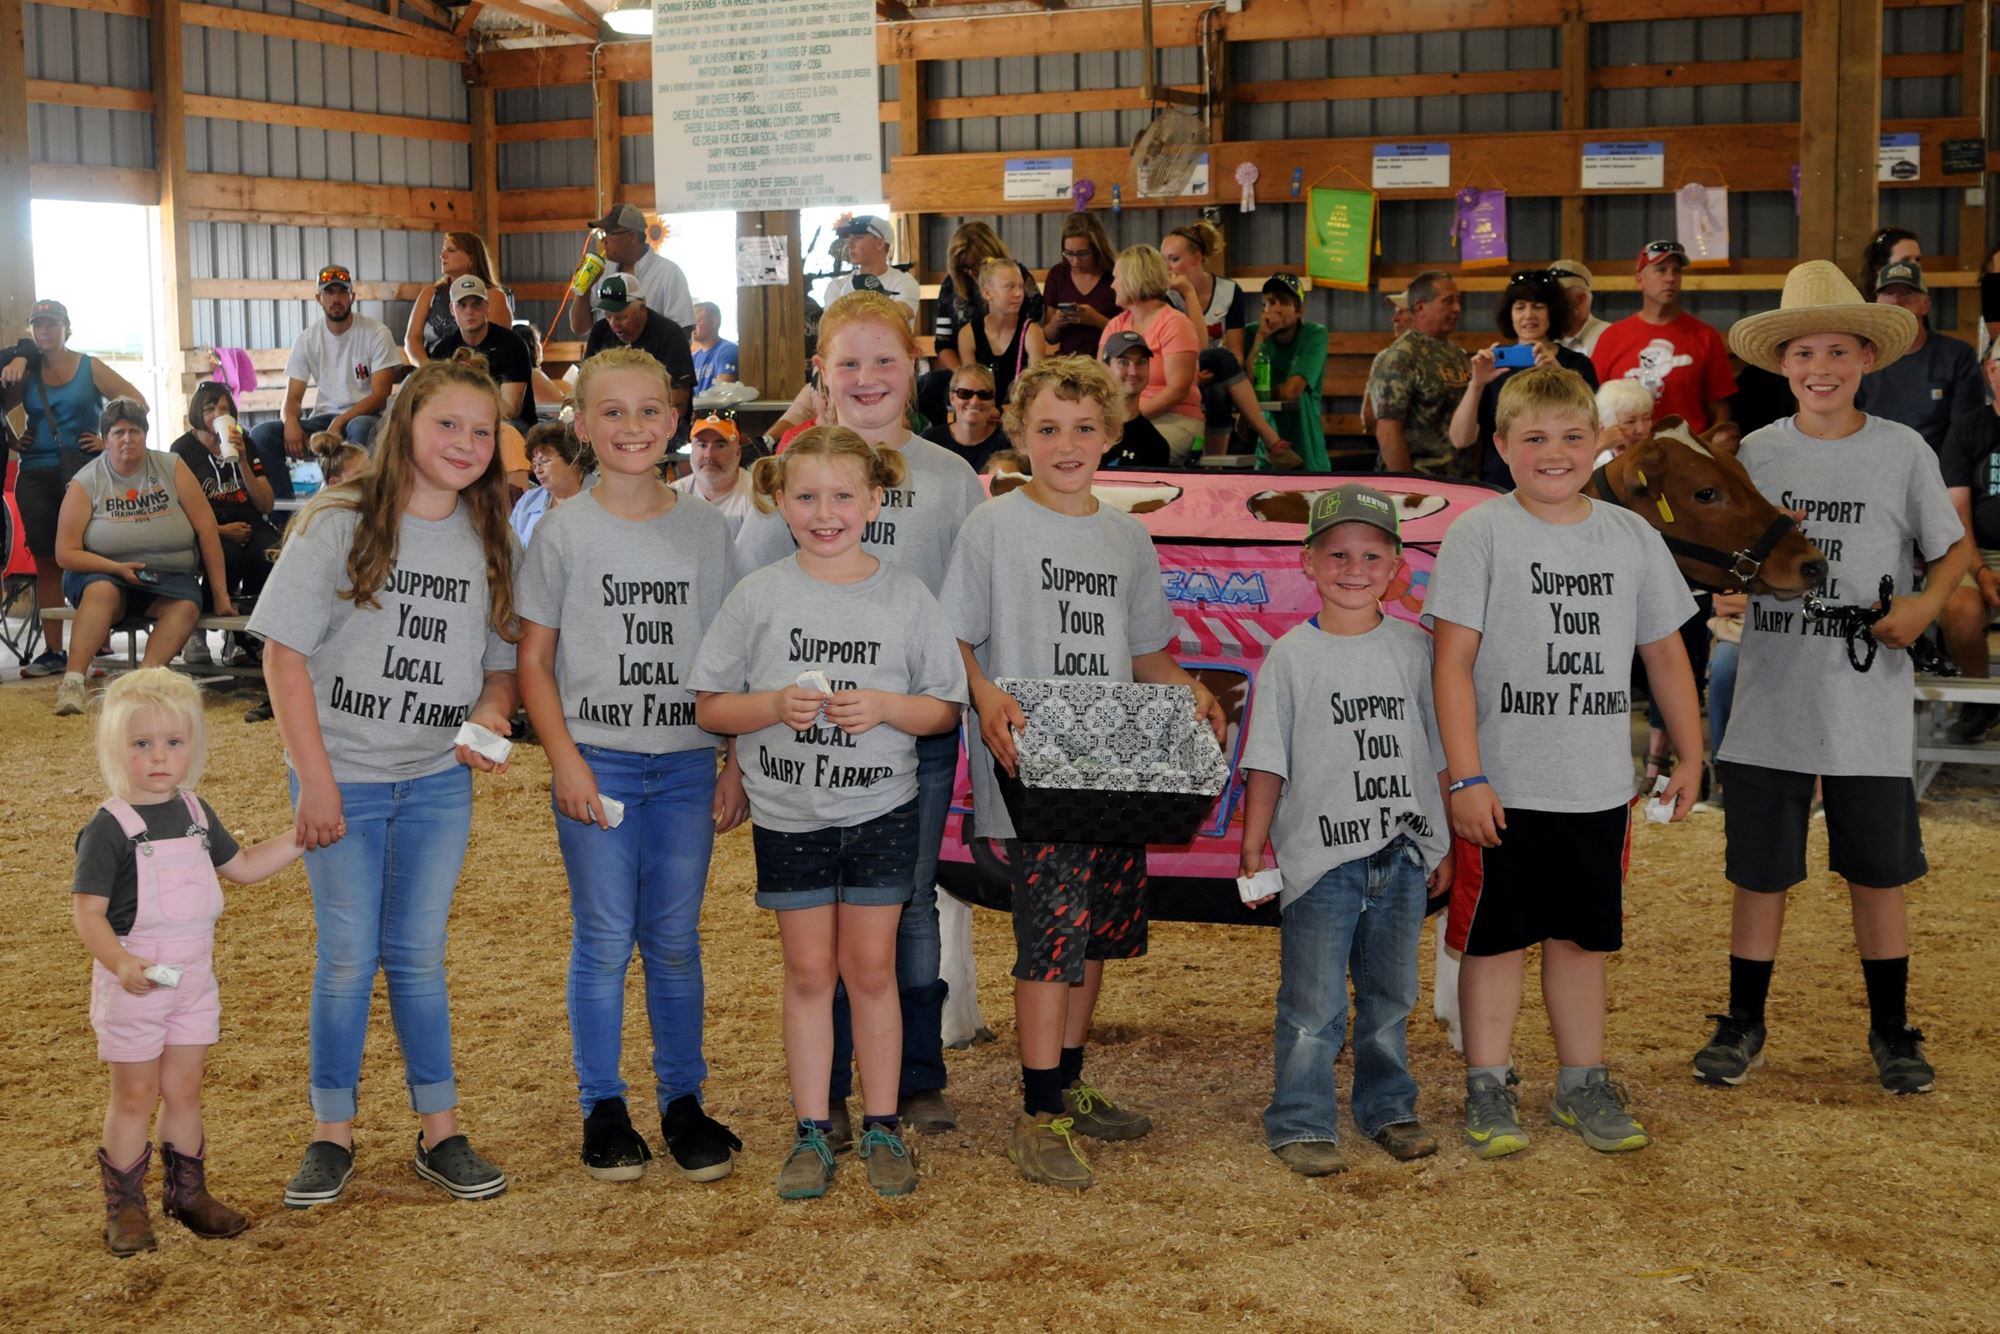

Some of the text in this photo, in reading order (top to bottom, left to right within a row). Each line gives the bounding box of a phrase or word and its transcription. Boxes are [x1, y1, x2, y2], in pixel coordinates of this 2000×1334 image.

[106, 489, 169, 512] BROWNS
[111, 503, 168, 518] TRAINING CAMP
[861, 520, 896, 545] OUR
[602, 574, 690, 607] SUPPORT
[1041, 558, 1117, 597] SUPPORT
[1161, 571, 1269, 604] EAM
[1531, 562, 1614, 596] SUPPORT
[397, 603, 448, 644] YOUR
[622, 613, 674, 645] YOUR
[1058, 600, 1105, 636] YOUR
[1550, 602, 1600, 635] YOUR
[1752, 601, 1794, 633] DAIRY
[789, 627, 881, 665] SUPPORT
[1054, 642, 1109, 676] LOCAL
[1546, 642, 1605, 675] LOCAL
[382, 645, 444, 685] LOCAL
[618, 653, 679, 686] LOCAL
[330, 676, 470, 728] DAIRY FARME
[579, 693, 696, 727] DAIRY FARM
[1331, 692, 1405, 725] SUPPORT
[1501, 682, 1628, 716] DAIRY FARMER
[760, 745, 893, 789] DAIRY FARMER
[1354, 771, 1412, 802] LOCAL
[1319, 815, 1371, 847] DAIRY
